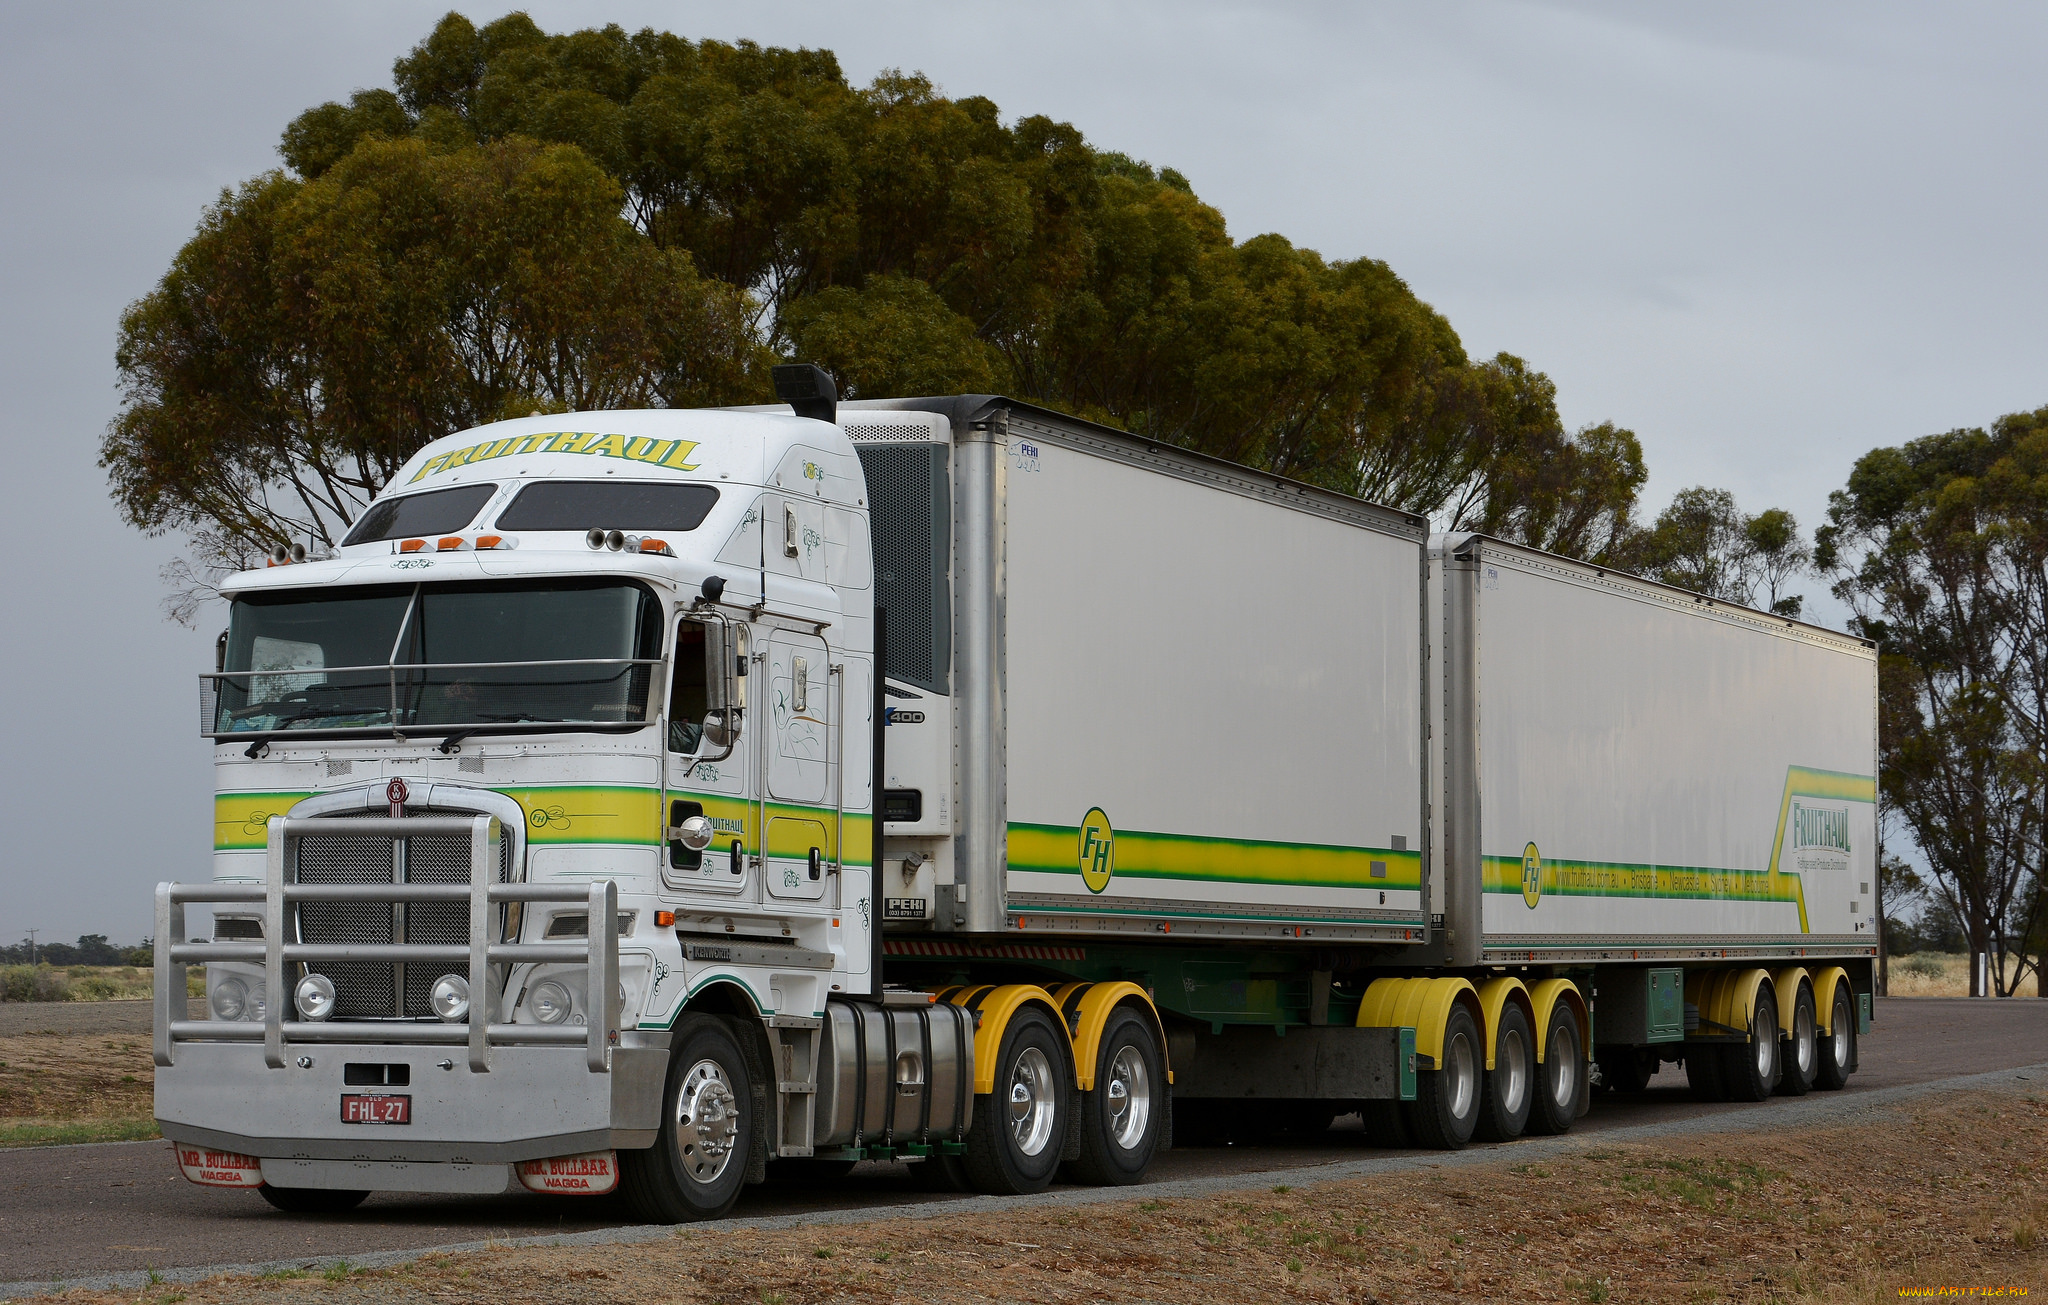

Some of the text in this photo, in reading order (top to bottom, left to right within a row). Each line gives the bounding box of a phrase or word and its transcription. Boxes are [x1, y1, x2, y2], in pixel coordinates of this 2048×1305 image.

[405, 432, 702, 485] FRUITHAUL
[1021, 443, 1039, 458] PEKI
[533, 813, 545, 823] FH
[1793, 802, 1851, 852] FRUITHAUL
[1082, 826, 1112, 873] FH
[1522, 857, 1540, 893] FH
[1631, 869, 1658, 890] Brisbane
[1669, 871, 1700, 892] Newcastle
[888, 898, 924, 910] PEKI
[693, 945, 731, 959] KENWORTH
[182, 1150, 204, 1168] MR.
[523, 1159, 610, 1176] MR. BULLBAR
[200, 1170, 243, 1182] WAGGA
[543, 1177, 590, 1189] WAGGA
